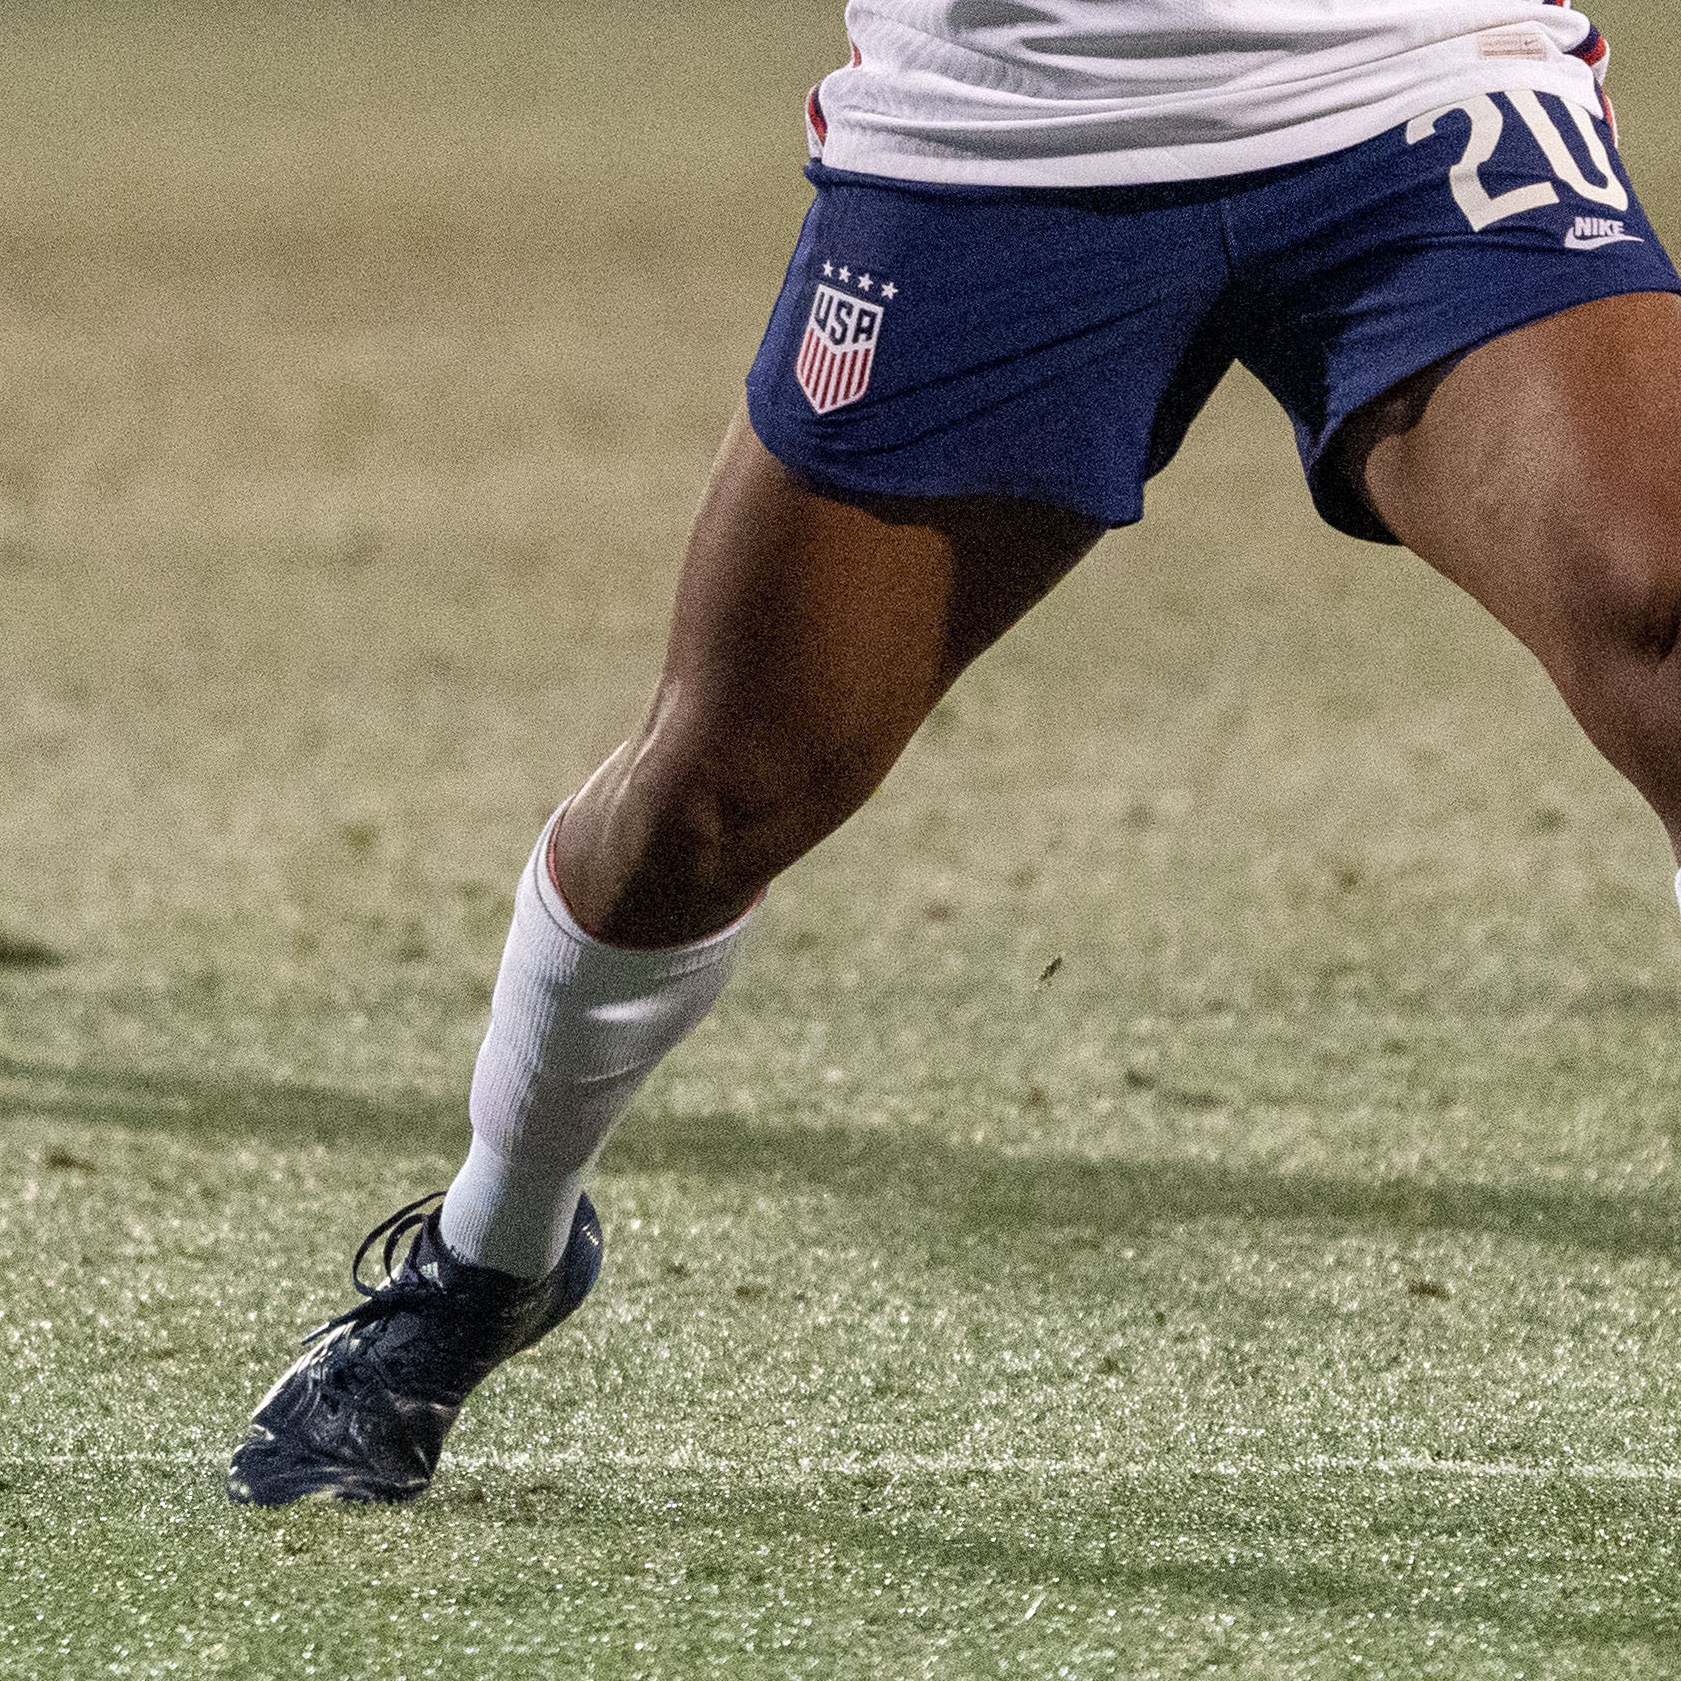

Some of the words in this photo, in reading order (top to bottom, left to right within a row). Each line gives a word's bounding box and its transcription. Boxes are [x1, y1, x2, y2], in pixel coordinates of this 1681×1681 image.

[1404, 87, 1630, 233] 20
[1573, 215, 1625, 238] NIKE
[814, 289, 879, 347] USA
